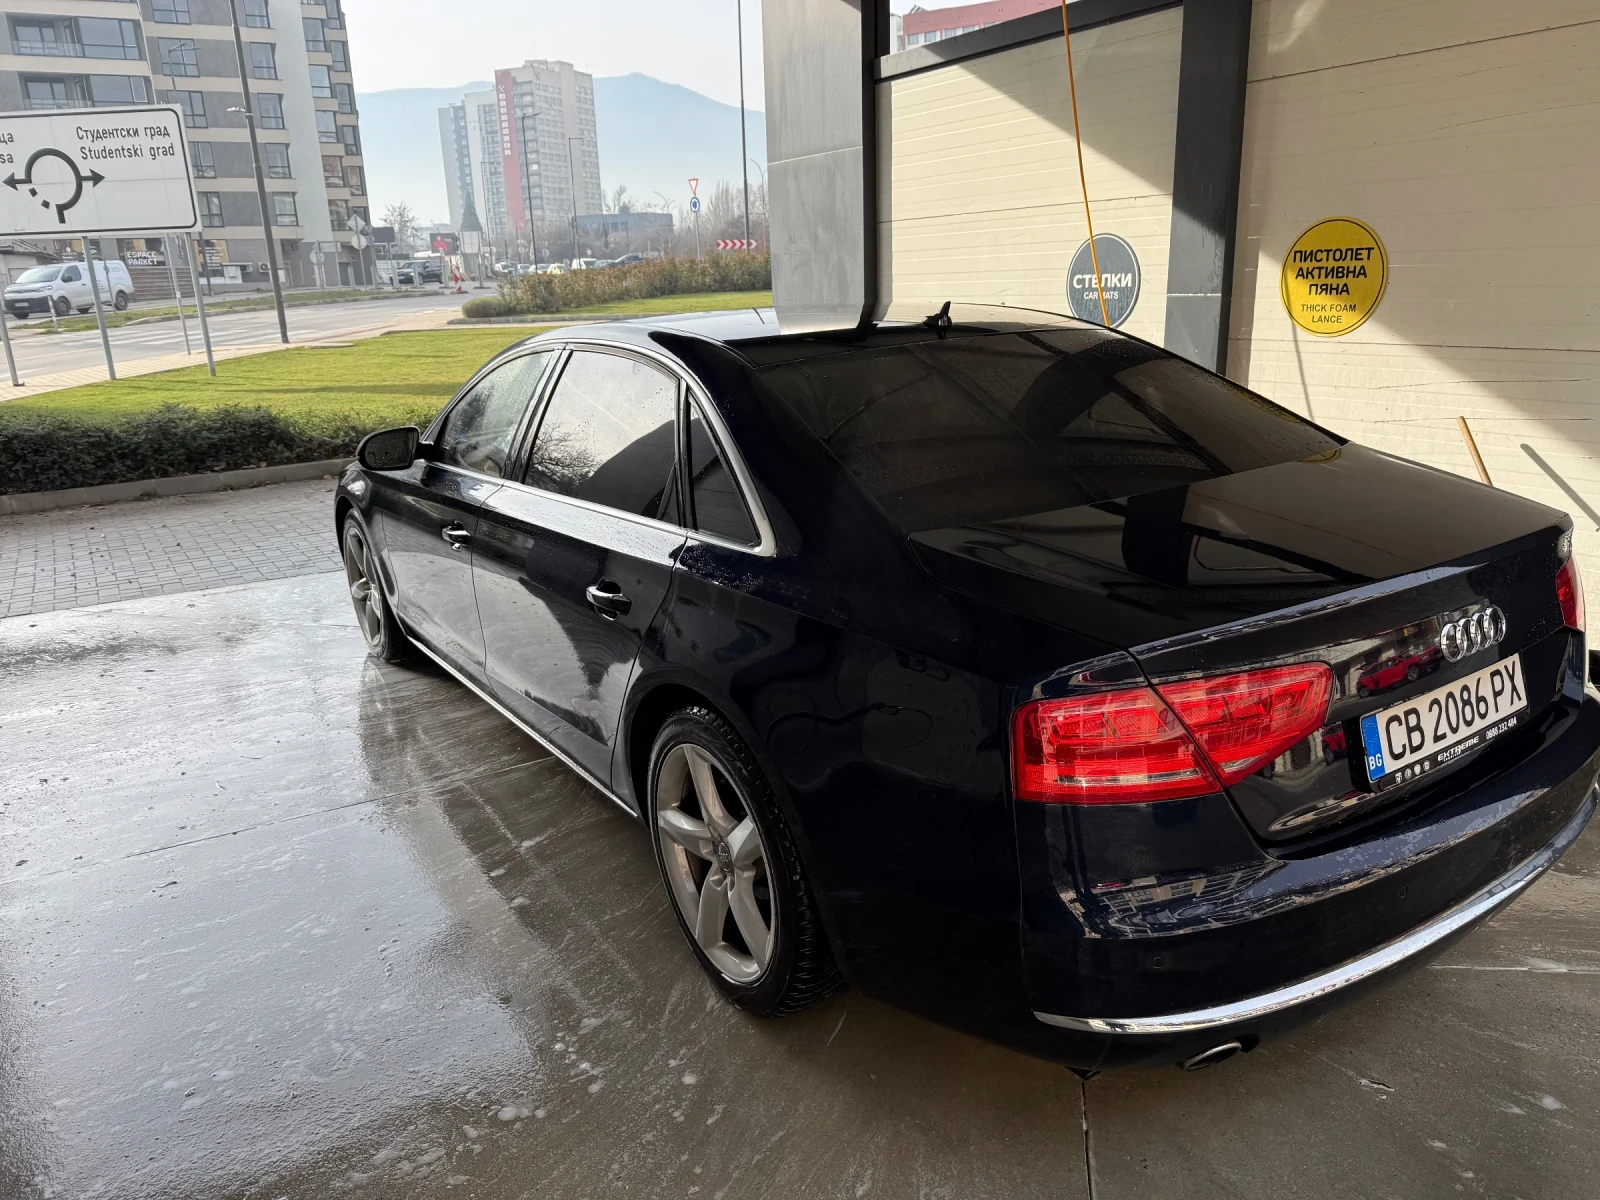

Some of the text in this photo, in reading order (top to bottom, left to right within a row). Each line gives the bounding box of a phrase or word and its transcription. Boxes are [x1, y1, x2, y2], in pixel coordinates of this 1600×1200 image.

[76, 125, 170, 142] Студентски град
[80, 143, 175, 160] Studentski grad
[128, 258, 158, 266] PARKET
[1292, 247, 1375, 263] ПИСТОЛЕТ
[1295, 264, 1368, 280] АКТИВНА
[1083, 291, 1098, 300] CAR
[1308, 281, 1350, 297] ПЯНА
[1301, 303, 1357, 313] THICK FOAM
[1312, 314, 1343, 324] LANCE
[1385, 660, 1522, 761] CB 2086 PX
[1368, 753, 1383, 771] BG
